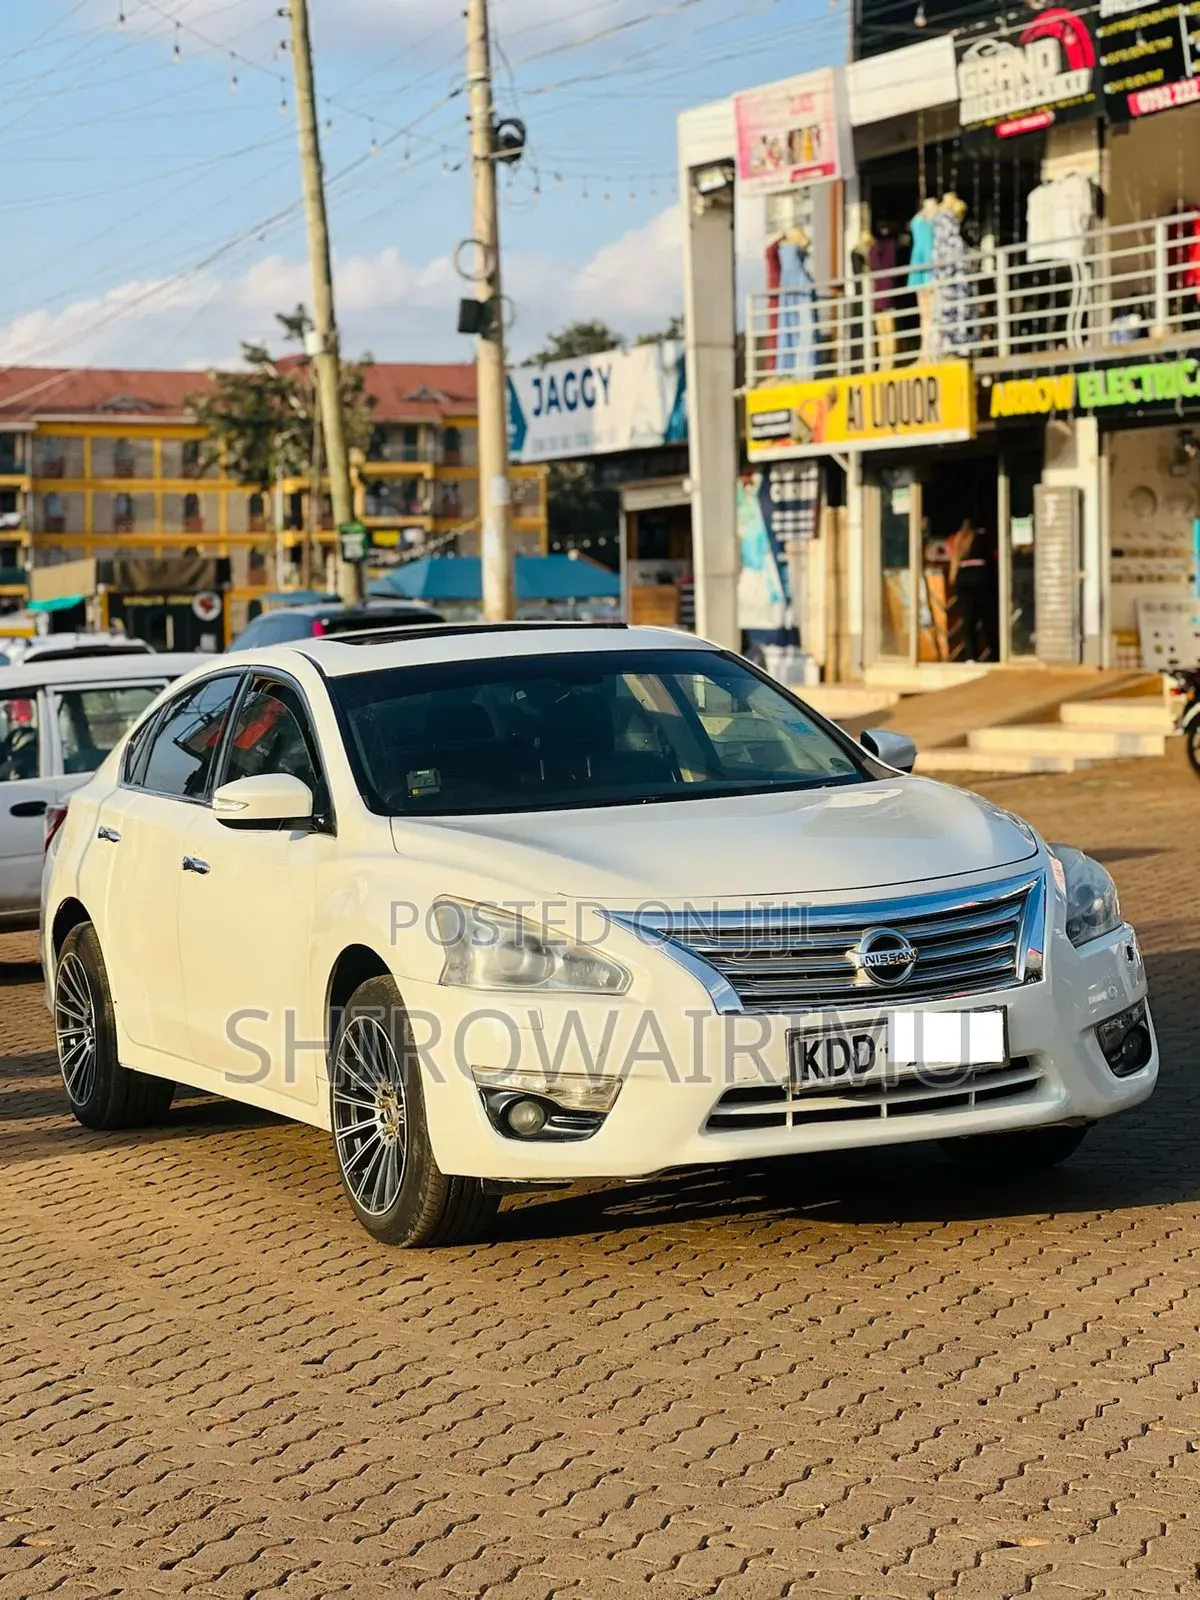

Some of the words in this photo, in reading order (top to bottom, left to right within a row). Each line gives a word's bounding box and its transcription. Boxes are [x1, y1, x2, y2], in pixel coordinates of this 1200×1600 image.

[531, 365, 612, 417] JAGGY
[847, 386, 865, 431] A1
[871, 376, 941, 432] LIQUOR
[1077, 359, 1200, 408] ELECTRIC
[865, 950, 914, 965] NISSAN
[801, 1034, 876, 1081] KDD
